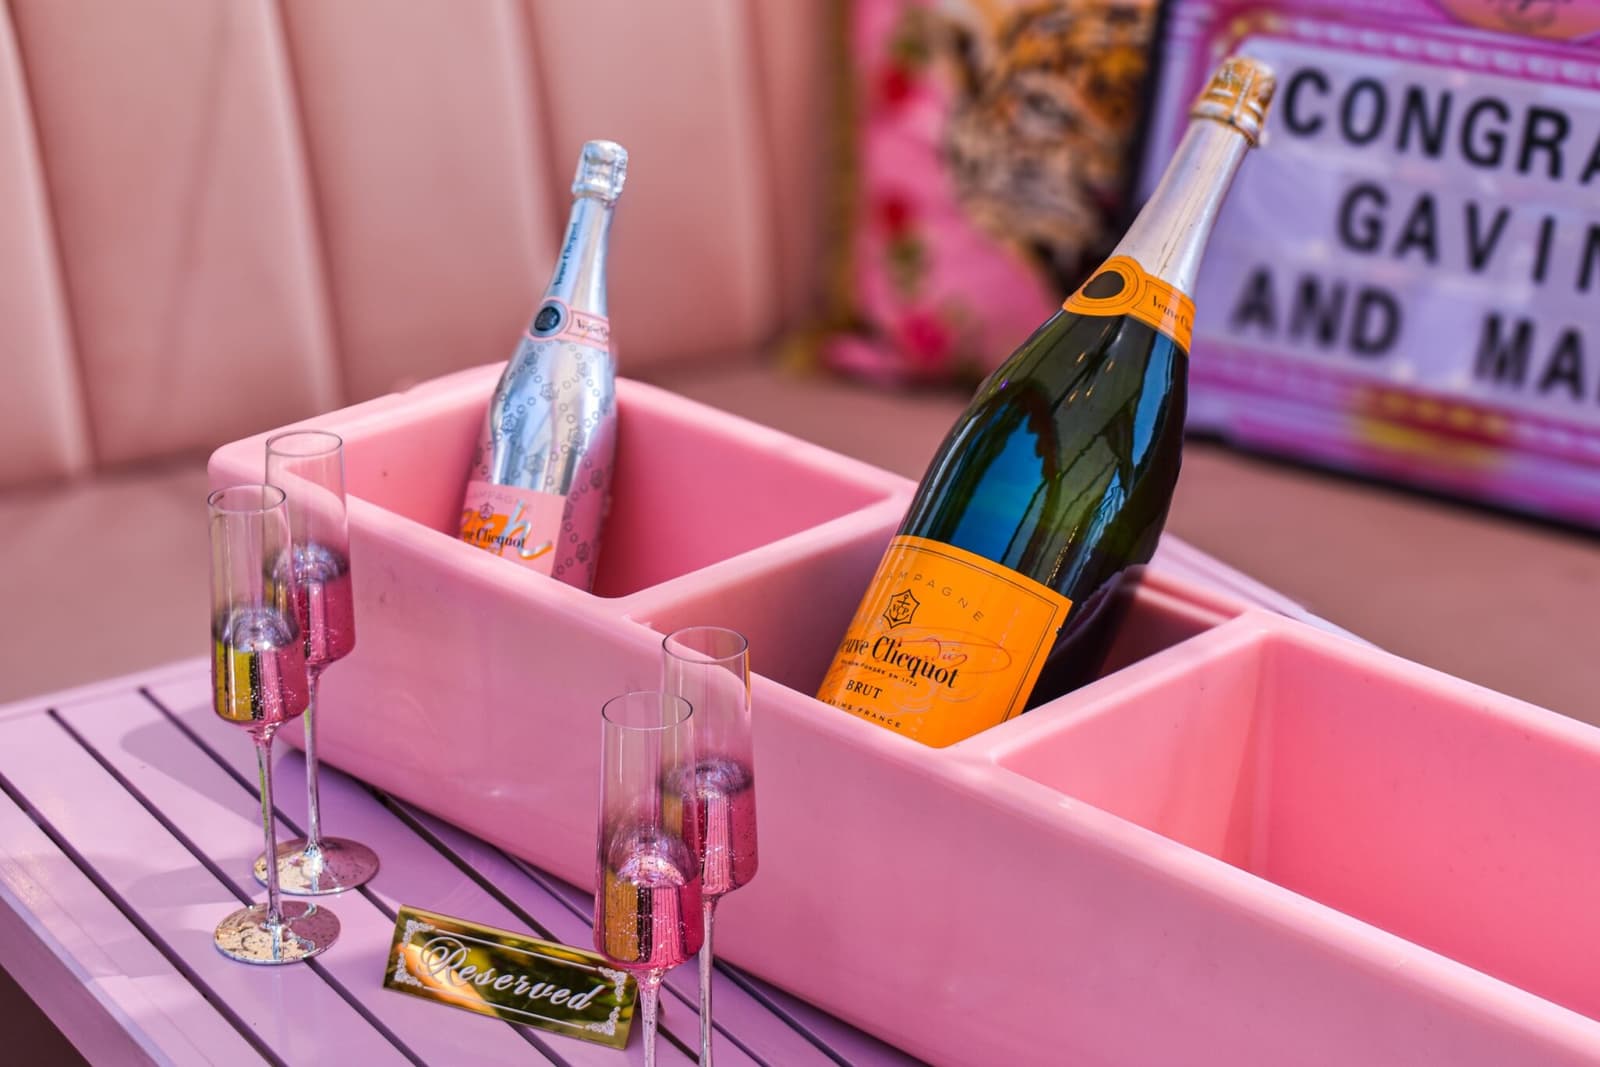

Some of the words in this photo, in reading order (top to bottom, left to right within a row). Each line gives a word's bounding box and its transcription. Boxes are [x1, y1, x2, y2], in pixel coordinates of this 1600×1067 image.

[1230, 266, 1402, 359] AND
[1474, 311, 1600, 405] MA
[872, 635, 959, 688] Clicquot
[845, 679, 883, 699] BRUT
[858, 706, 903, 728] FRANCE
[416, 936, 606, 1012] Reserved
